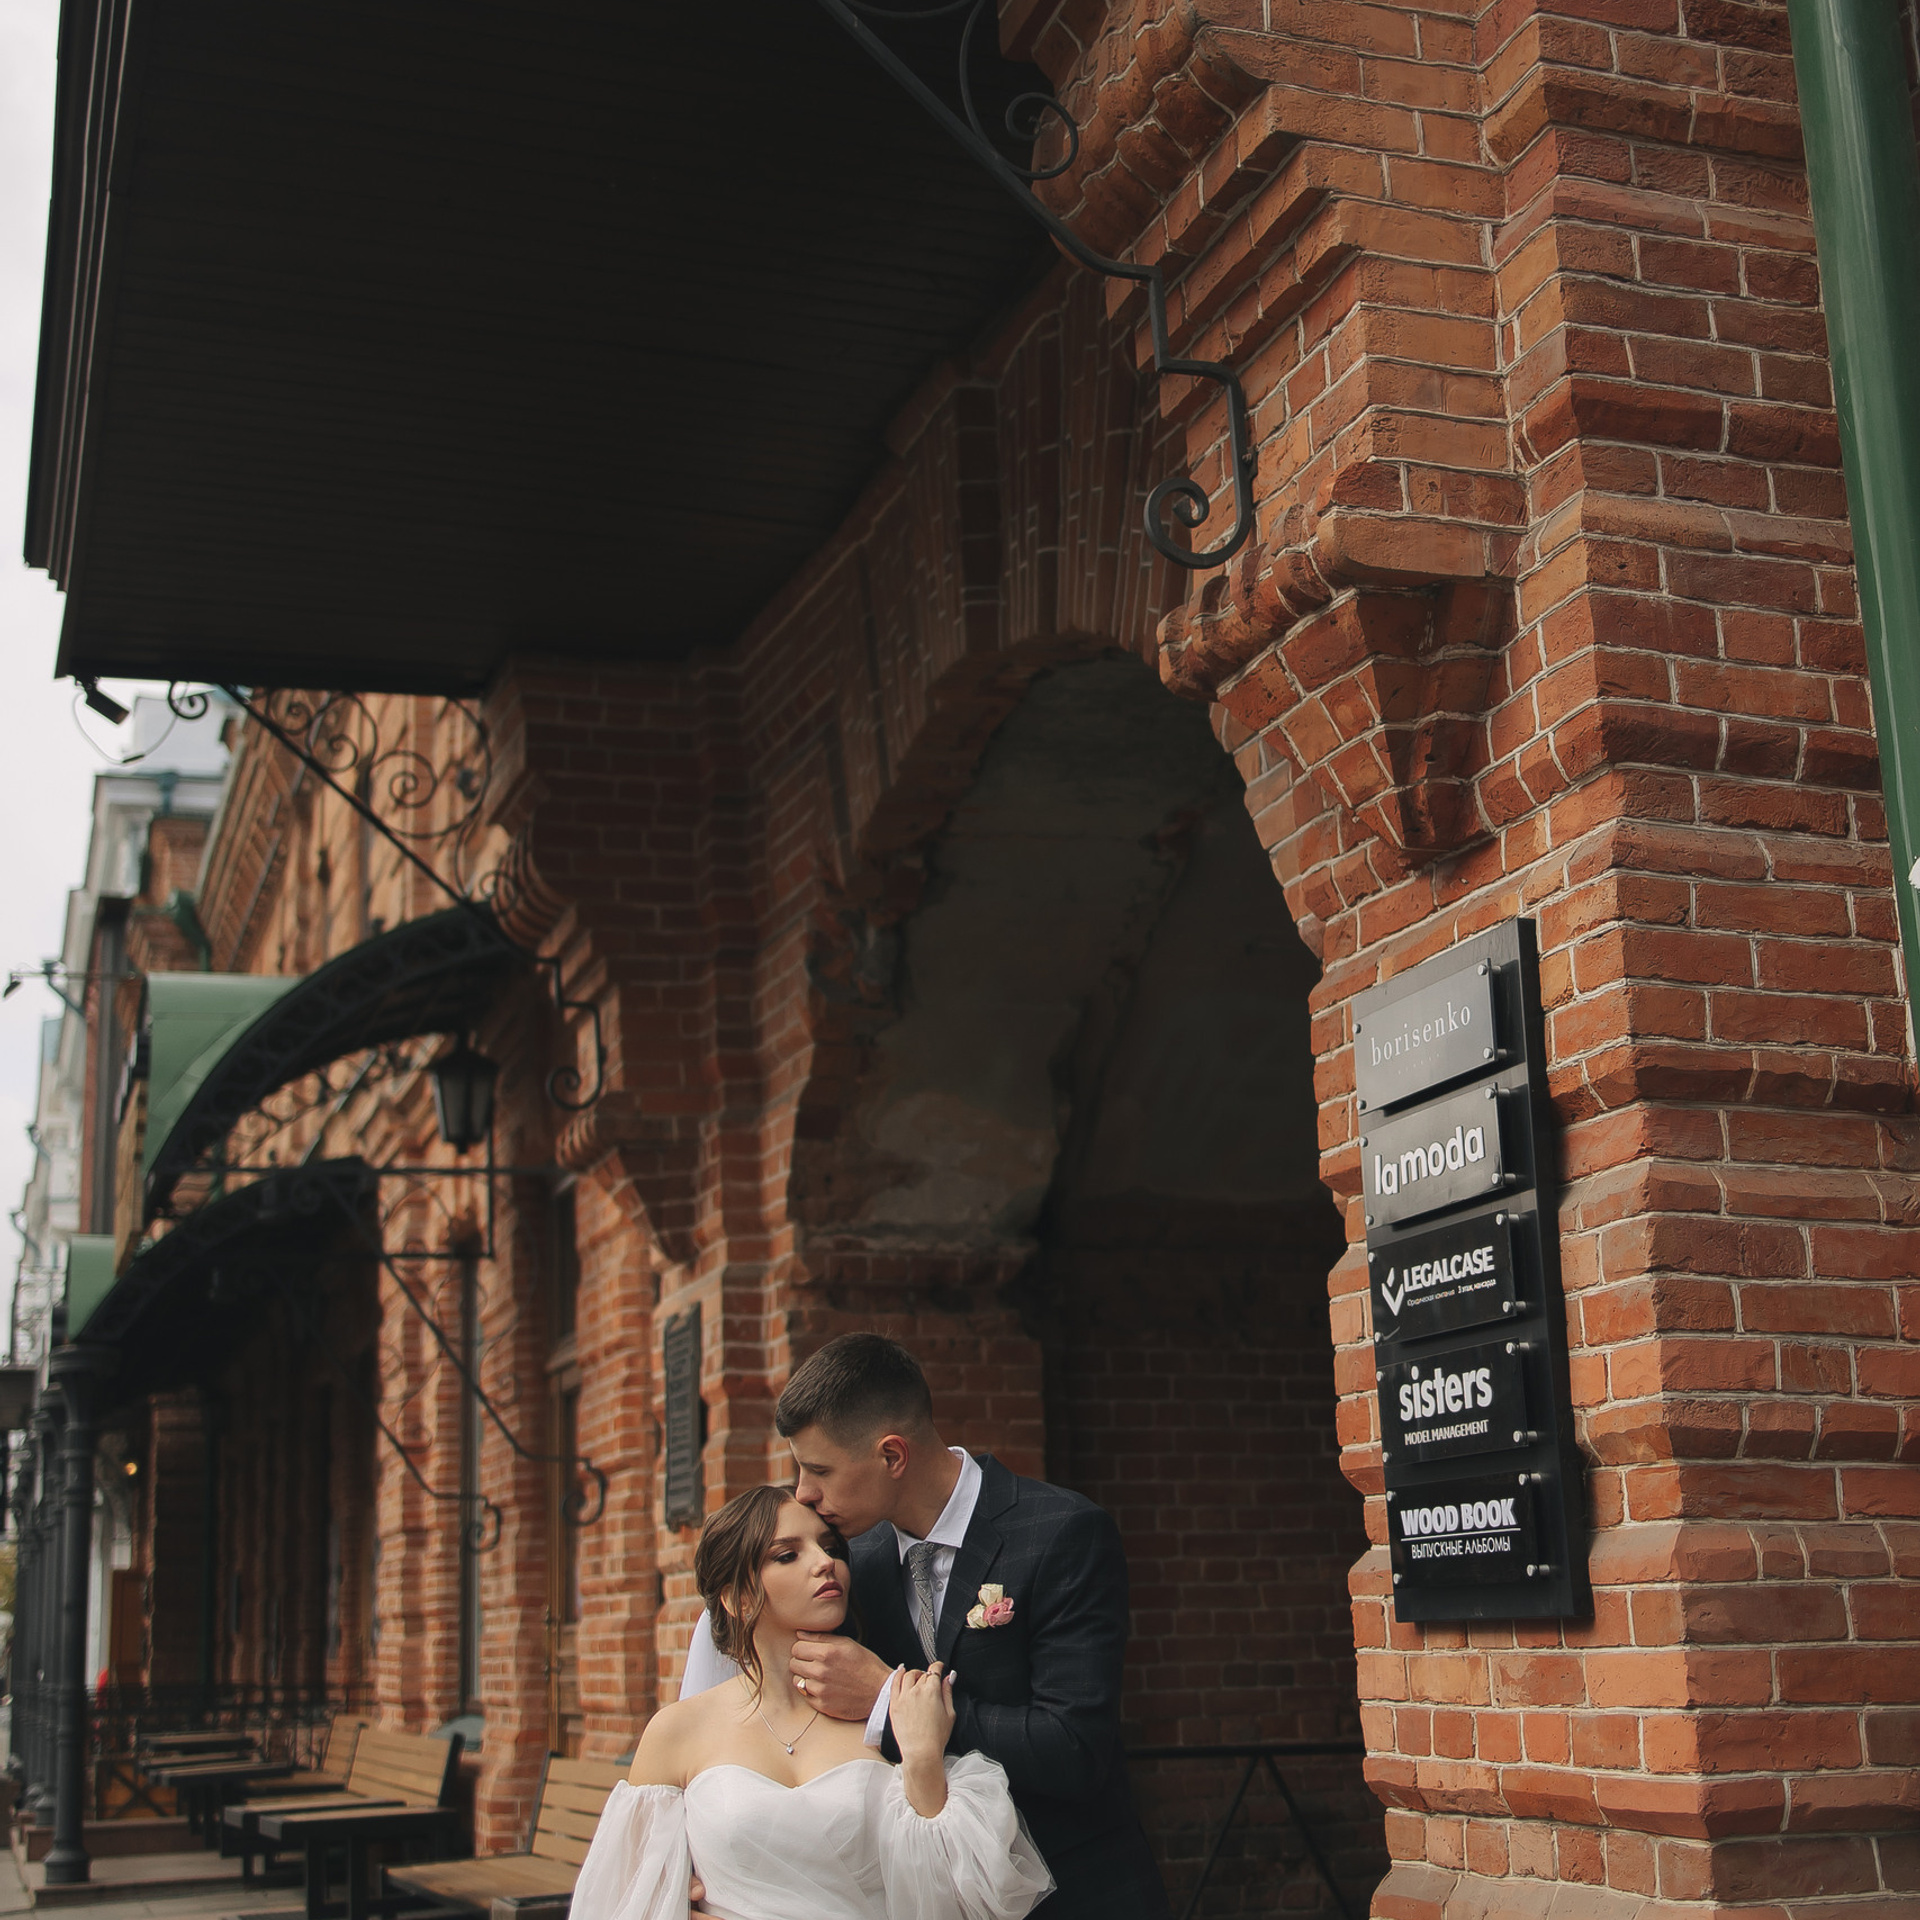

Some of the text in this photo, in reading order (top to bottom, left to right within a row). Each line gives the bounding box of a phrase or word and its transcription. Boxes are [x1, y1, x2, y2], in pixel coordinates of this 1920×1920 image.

[1370, 1001, 1471, 1067] borisenko
[1375, 1126, 1485, 1195] lamoda
[1403, 1246, 1495, 1292] LEGALCASE
[1399, 1365, 1493, 1422] sisters
[1404, 1419, 1490, 1446] MODEL MANAGEMENT
[1400, 1498, 1517, 1536] WOOD BOOK
[1411, 1536, 1511, 1559] ВЫПУСКНЫЕ АЛЬБОМЫ
